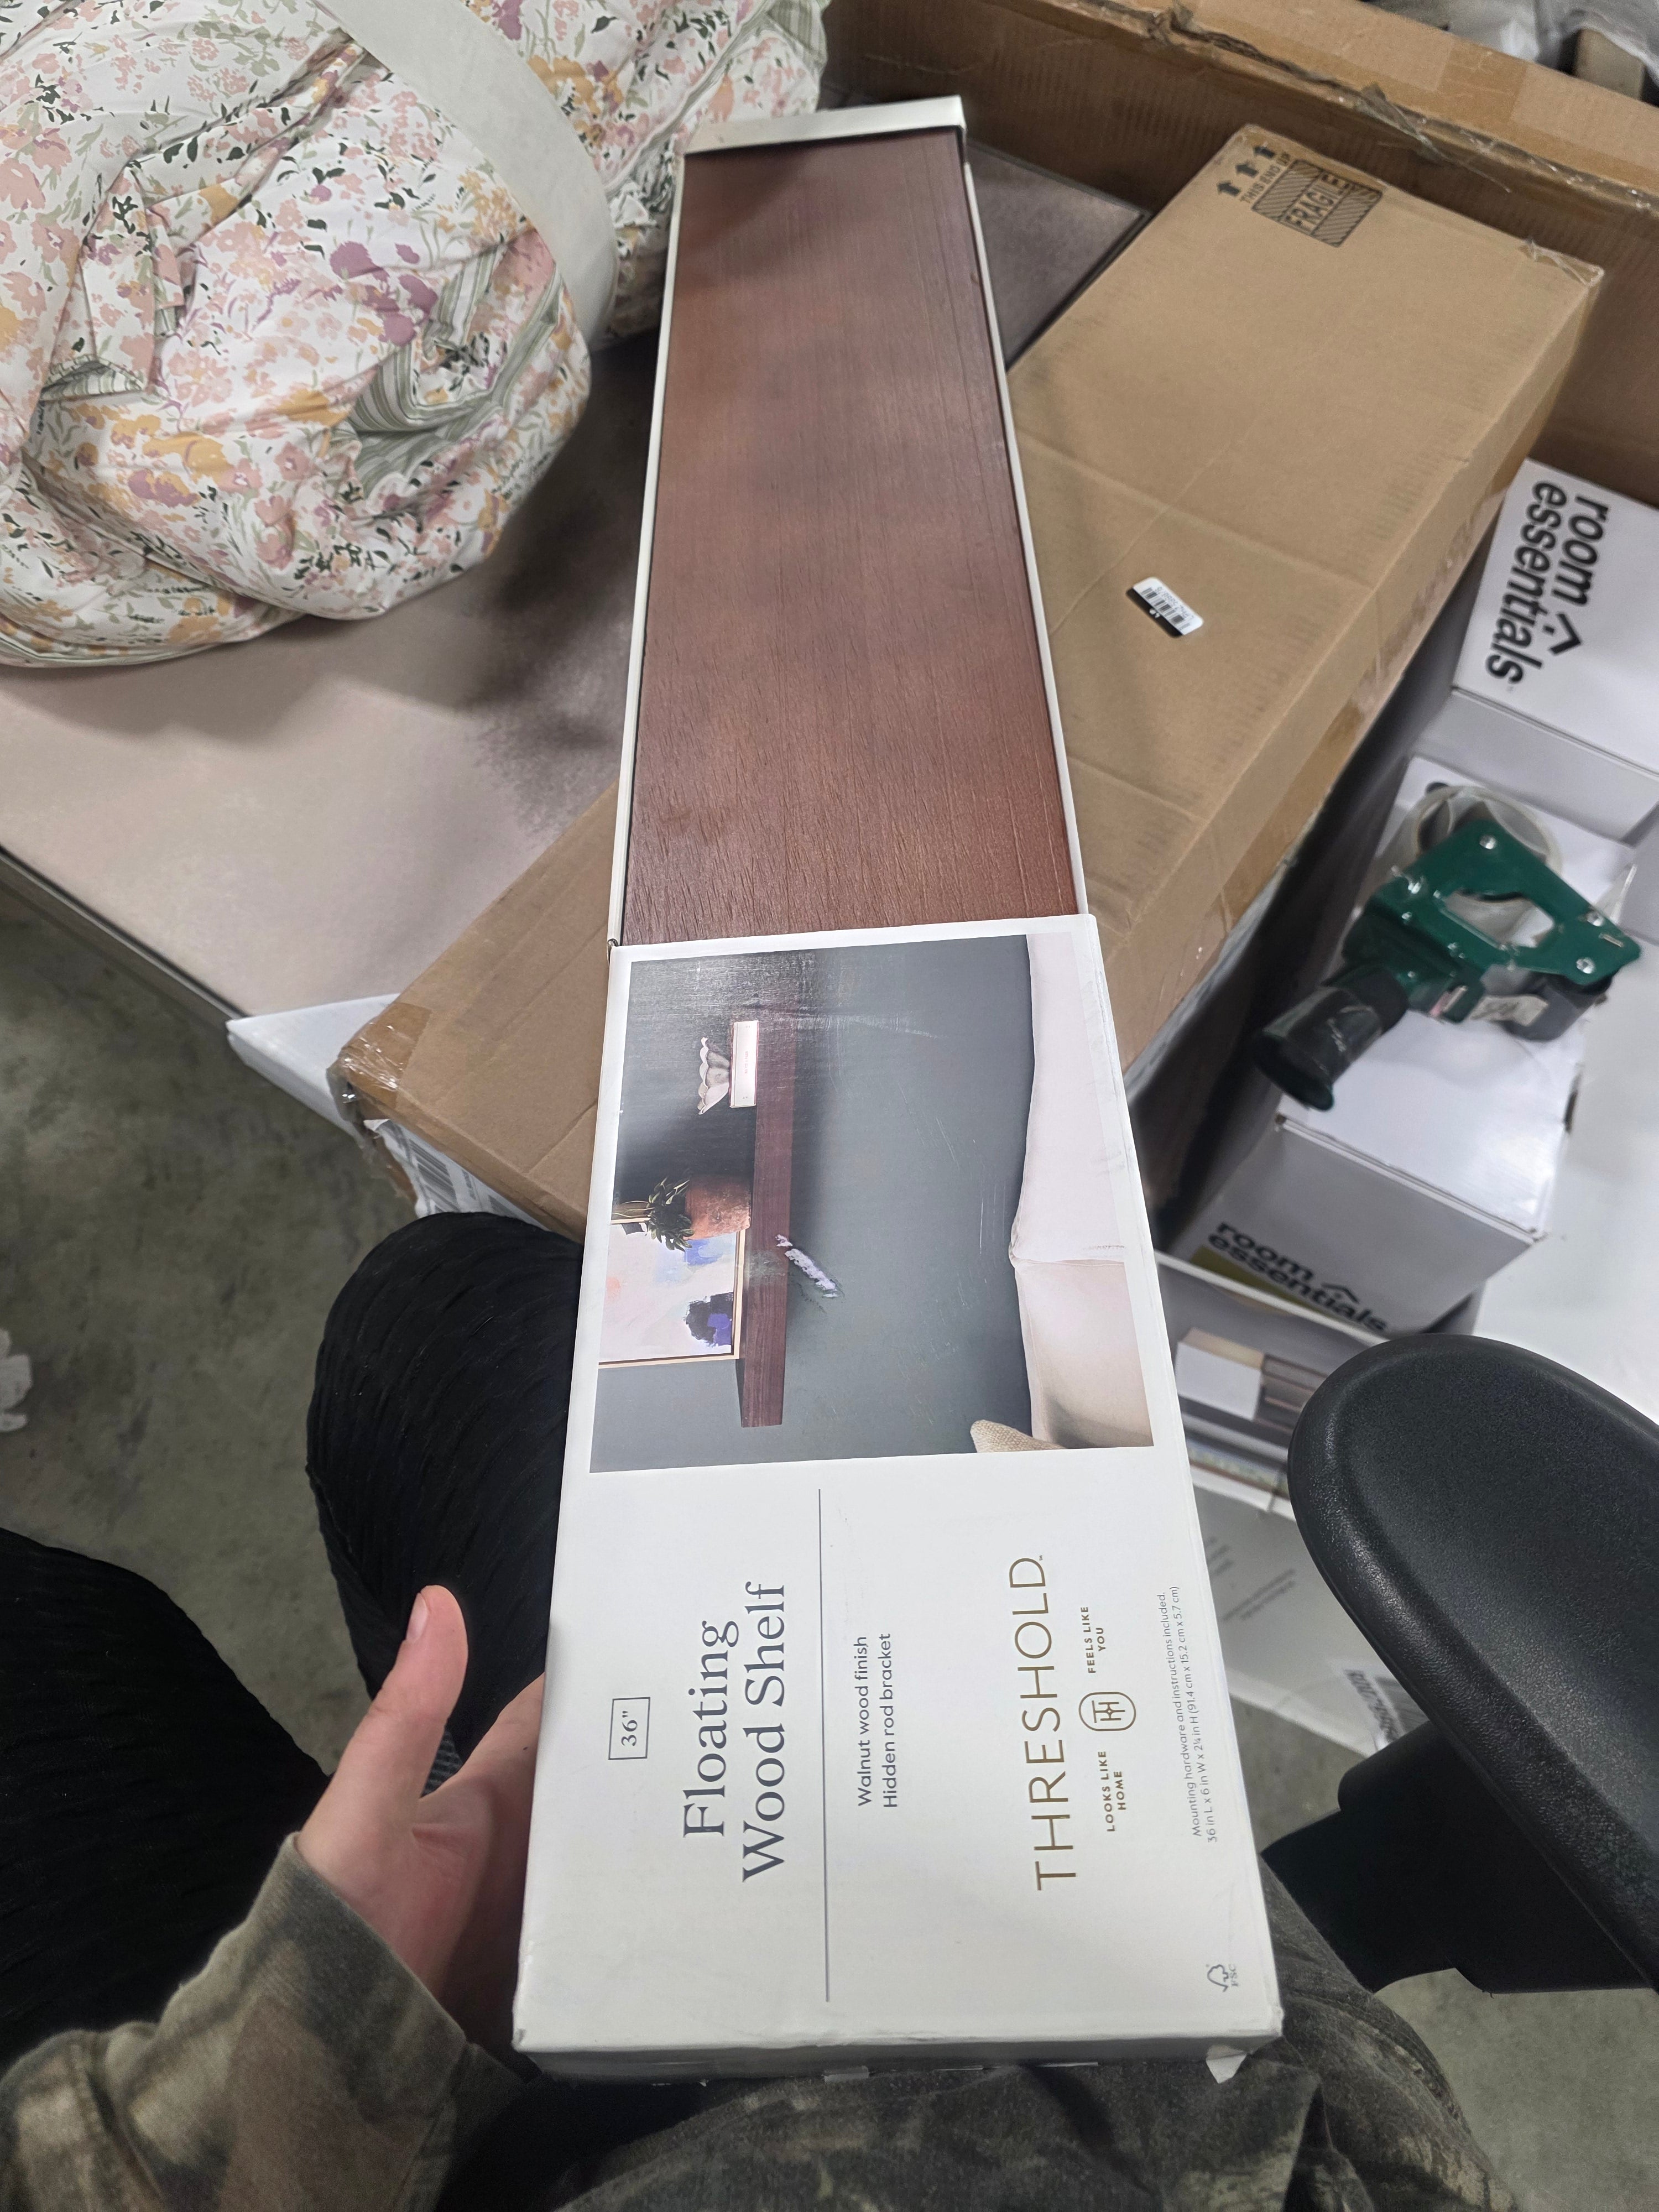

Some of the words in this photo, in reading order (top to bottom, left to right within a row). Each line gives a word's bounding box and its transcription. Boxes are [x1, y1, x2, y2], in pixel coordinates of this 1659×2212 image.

[1239, 182, 1265, 204] THIS
[1260, 165, 1280, 184] END
[1276, 152, 1290, 166] UP
[1286, 174, 1350, 232] FRAGILE
[1551, 495, 1609, 605] room
[1485, 481, 1567, 684] essentials
[1218, 1222, 1313, 1281] room
[1208, 1234, 1387, 1331] essentials
[1157, 1593, 1171, 1636] included.
[1170, 1587, 1179, 1603] cm)
[1172, 1606, 1182, 1619] 5.7
[1081, 1607, 1091, 1632] LIKE
[1096, 1628, 1105, 1651] YOU
[1178, 1629, 1185, 1642] cm
[744, 1582, 784, 1707] Shelf
[854, 1637, 868, 1680] finish
[1084, 1638, 1096, 1673] FEELS
[1178, 1646, 1188, 1663] 15.2
[878, 1634, 893, 1699] bracket
[1165, 1639, 1181, 1699] instructions
[1185, 1674, 1192, 1688] cm
[855, 1686, 869, 1734] wood
[880, 1706, 894, 1735] rod
[1173, 1702, 1183, 1721] and
[1186, 1692, 1199, 1713] (91.4
[621, 1711, 637, 1746] 36"
[683, 1621, 739, 1838] Floating
[857, 1740, 872, 1806] Walnut
[1098, 1752, 1109, 1780] LIKE
[1178, 1725, 1192, 1779] hardware
[1197, 1762, 1206, 1772] W
[881, 1742, 898, 1807] Hidden
[1114, 1772, 1126, 1810] HOME
[1199, 1776, 1208, 1785] in
[743, 1724, 785, 1882] Wood
[1102, 1786, 1115, 1832] LOOKS
[1187, 1782, 1201, 1836] Mounting
[1206, 1816, 1214, 1825] in
[1207, 1829, 1217, 1842] 36
